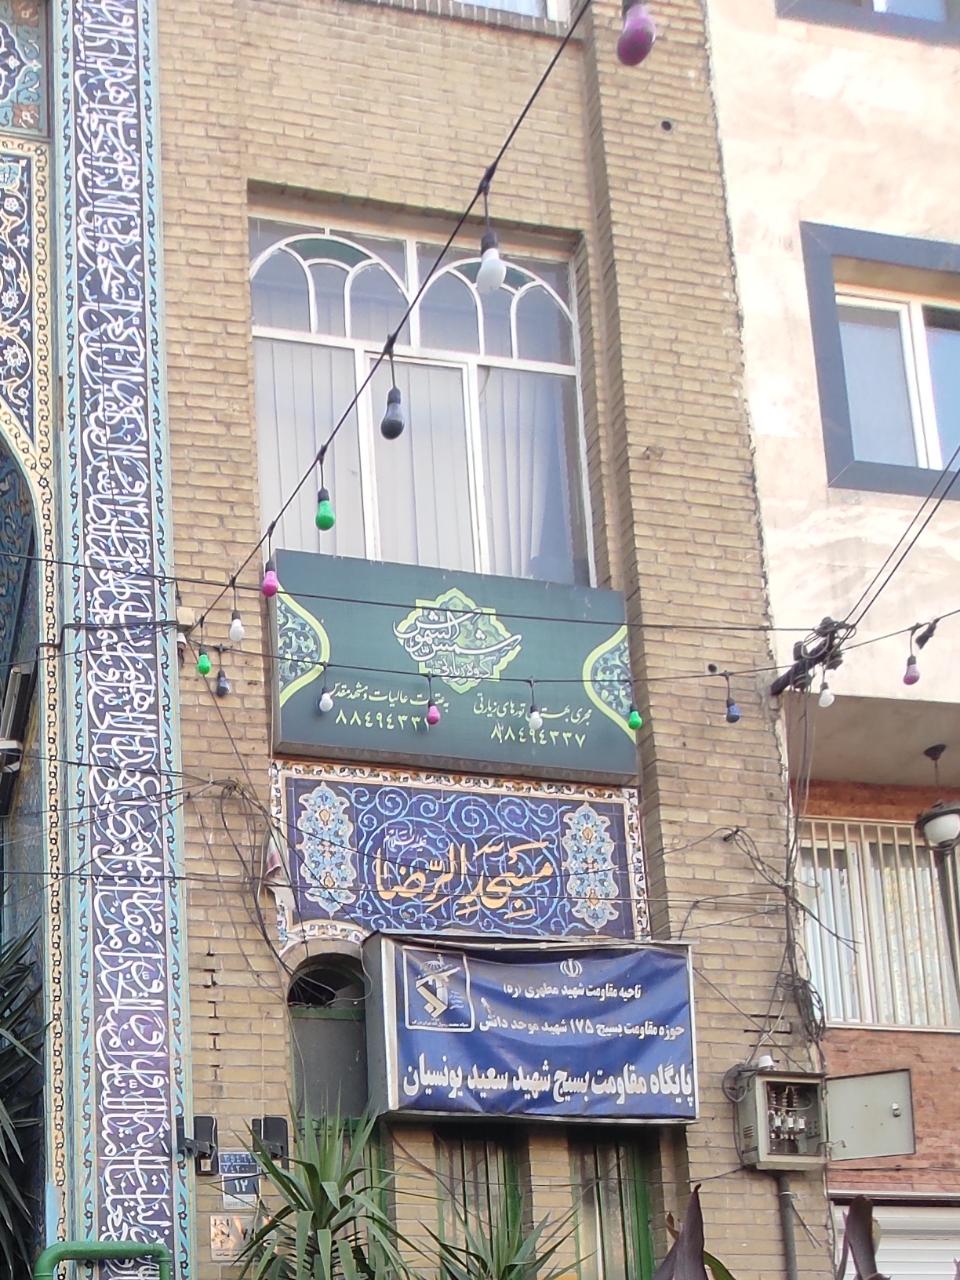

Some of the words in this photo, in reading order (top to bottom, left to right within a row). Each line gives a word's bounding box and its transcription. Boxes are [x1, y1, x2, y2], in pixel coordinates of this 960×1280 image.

[375, 842, 468, 914] الرضا
[456, 841, 554, 919] مسجد
[523, 983, 559, 999] مطهری
[560, 984, 589, 1000] شهید
[588, 983, 619, 1001] مقاومت
[618, 984, 642, 1002] ناحیه
[479, 1014, 509, 1032] دانش
[510, 1021, 540, 1036] موحد
[541, 1018, 568, 1035] شهید
[570, 1018, 595, 1034] ۱۷۵
[595, 1022, 624, 1038] بسیج
[623, 1021, 658, 1040] مقاومت
[657, 1025, 685, 1041] حوزه
[403, 1053, 464, 1099] یونسیان
[467, 1064, 509, 1098] سعید
[512, 1059, 551, 1100] شهید
[553, 1067, 590, 1103] بسیج
[591, 1063, 647, 1105] مقاومت
[649, 1062, 694, 1108] پایگاه
